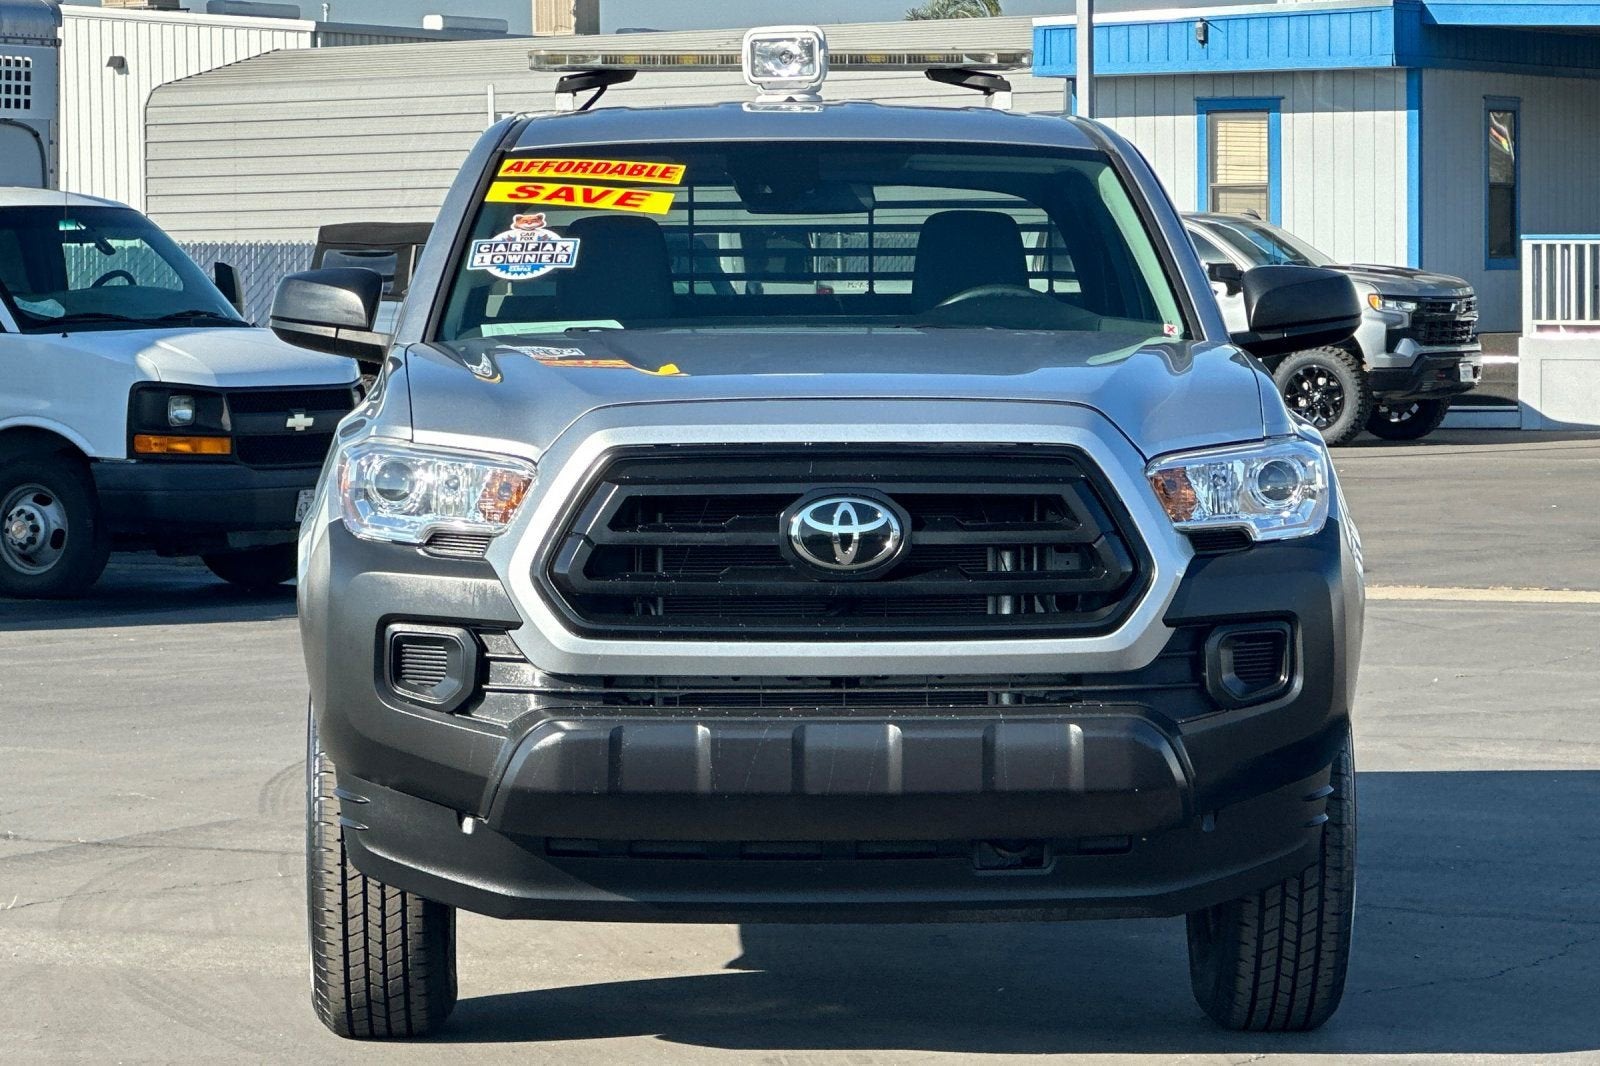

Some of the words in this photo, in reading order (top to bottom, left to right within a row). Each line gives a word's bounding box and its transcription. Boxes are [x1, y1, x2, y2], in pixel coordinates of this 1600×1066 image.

[503, 160, 679, 180] AFFORDABLE
[507, 184, 652, 207] SAVE
[479, 242, 570, 253] CARFAX
